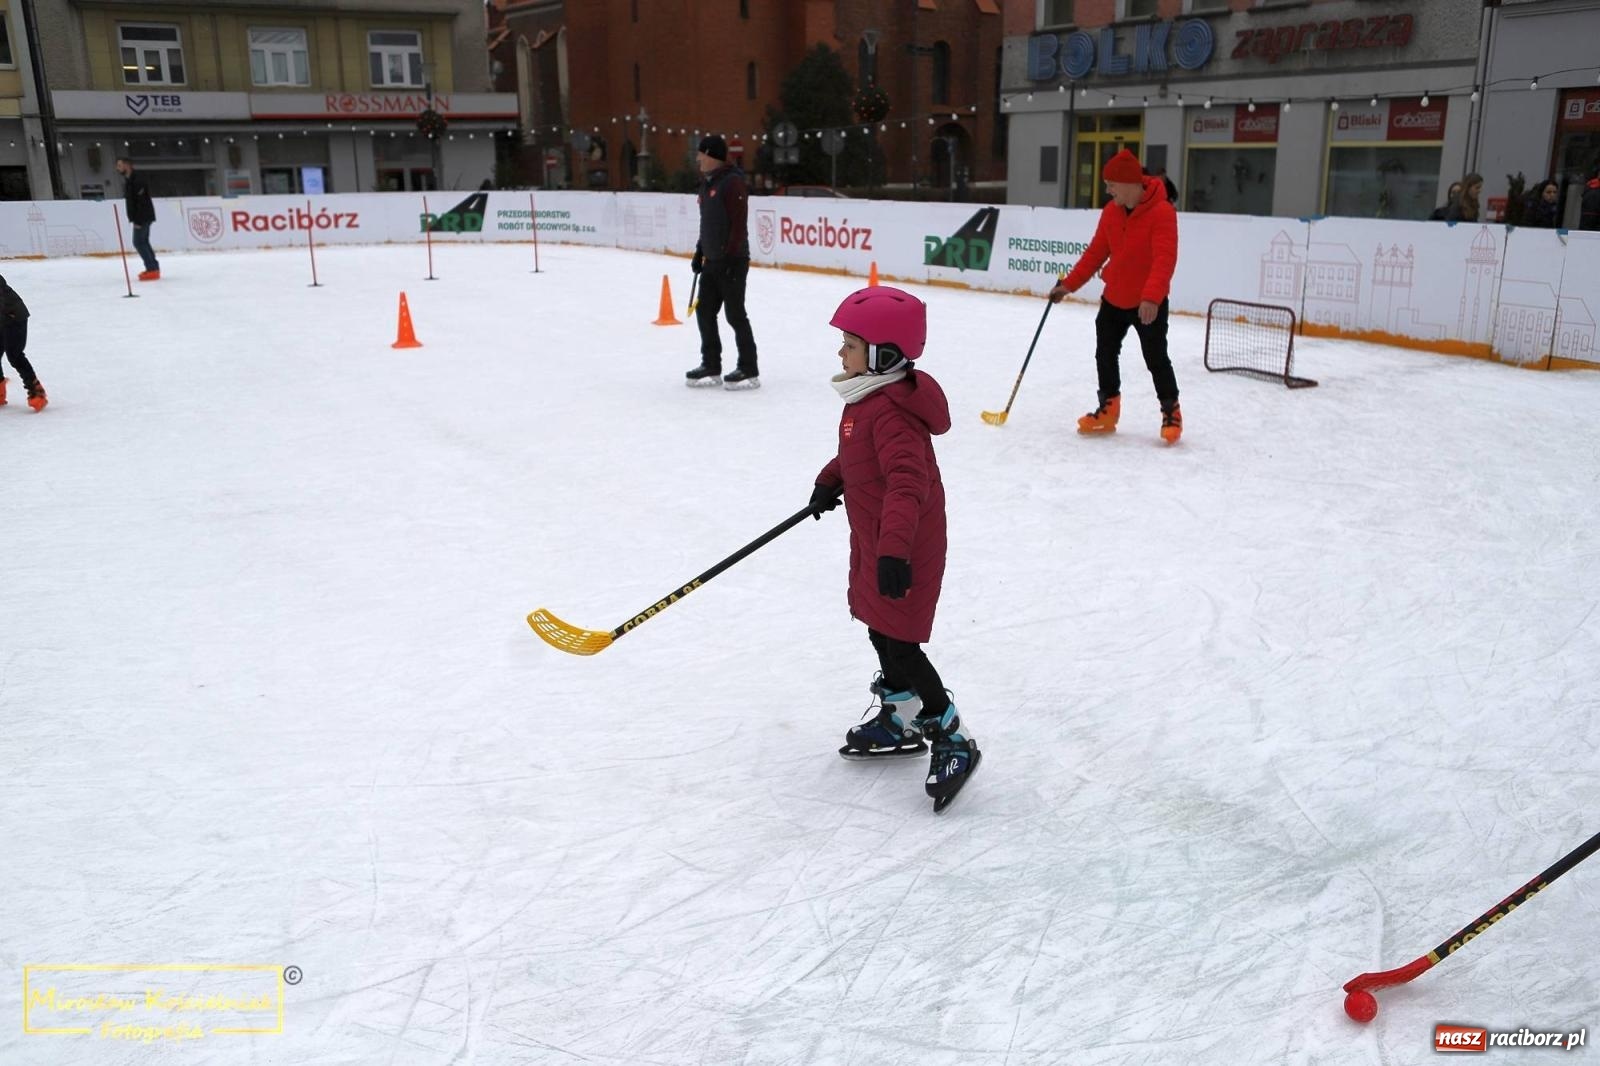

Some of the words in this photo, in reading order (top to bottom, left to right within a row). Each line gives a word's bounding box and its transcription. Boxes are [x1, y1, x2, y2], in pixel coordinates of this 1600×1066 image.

[1231, 14, 1413, 64] zaprasza
[150, 95, 181, 106] TEB
[325, 94, 449, 112] ROSSMANN
[232, 208, 360, 232] Racibórz
[420, 213, 482, 234] PRD
[497, 222, 524, 231] ROBÓT
[780, 217, 872, 251] Racibórz
[924, 235, 990, 272] PRD
[1008, 237, 1089, 256] PRZEDSIĘBIORS
[1008, 257, 1041, 272] ROBÓT
